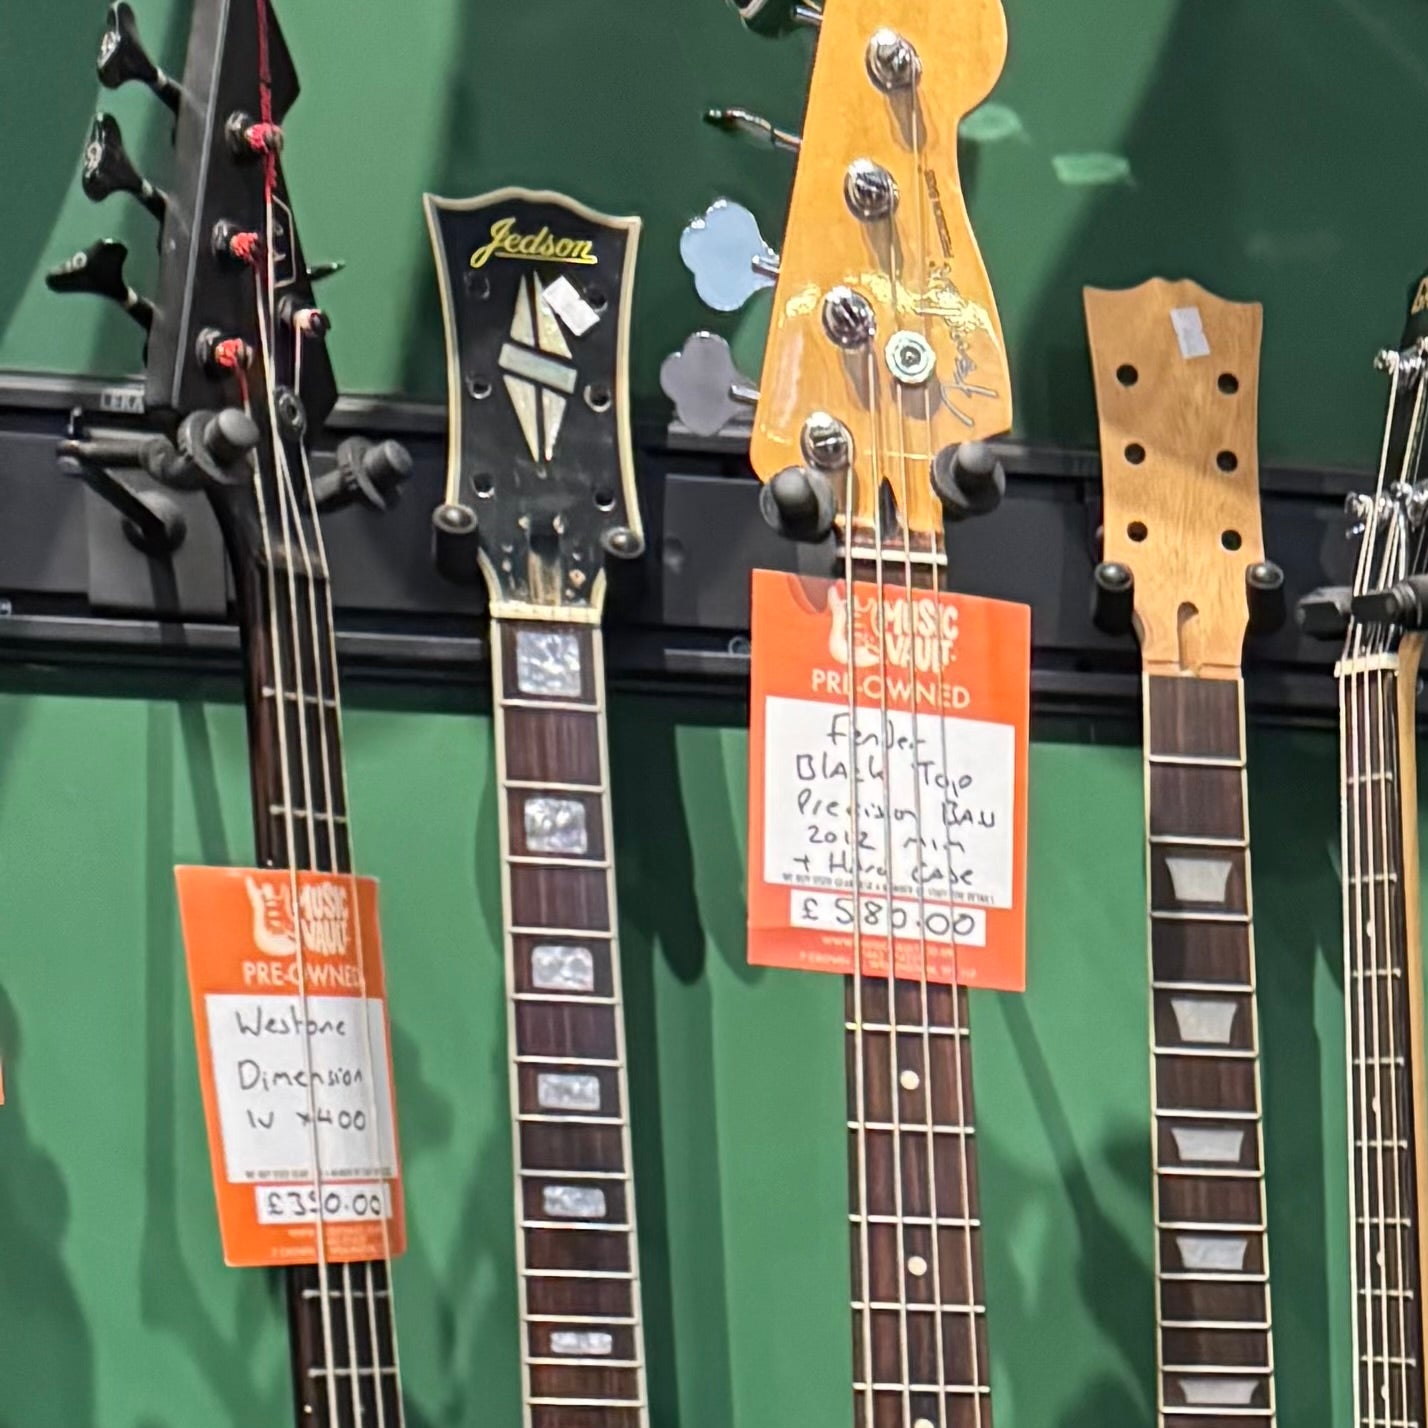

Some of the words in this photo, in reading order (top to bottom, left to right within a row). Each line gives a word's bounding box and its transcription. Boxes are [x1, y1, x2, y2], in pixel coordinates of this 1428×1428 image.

[470, 216, 598, 269] Jedson
[885, 597, 960, 638] MUSIC
[887, 634, 957, 674] VAULT
[811, 668, 971, 710] PRE-OWNED
[808, 825, 876, 851] 2012
[299, 881, 349, 921] MUSIC
[300, 918, 351, 957] VAULT
[235, 1005, 346, 1037] Westone
[238, 1059, 363, 1093] Dimension
